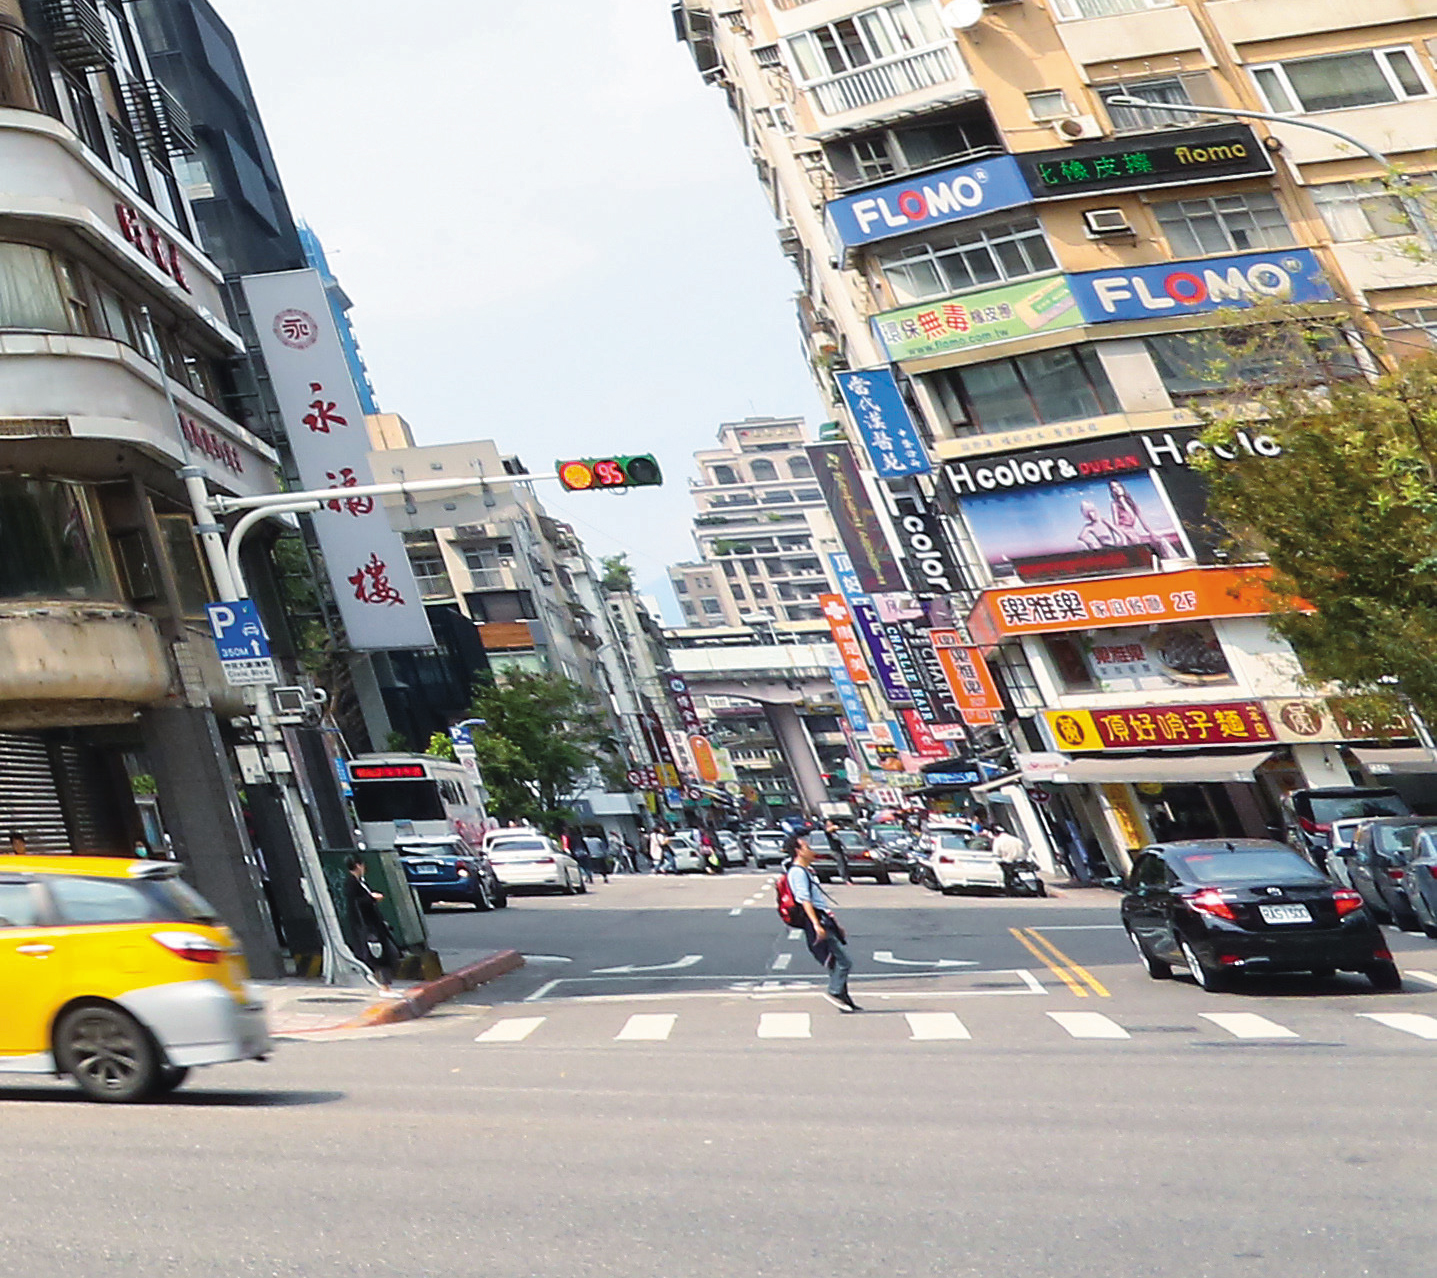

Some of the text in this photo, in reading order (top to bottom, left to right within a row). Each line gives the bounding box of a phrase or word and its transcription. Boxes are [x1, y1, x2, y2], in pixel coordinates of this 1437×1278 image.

[851, 172, 984, 235] FLOMO
[1092, 260, 1292, 314] FLOMO
[301, 382, 408, 609] 永福樓
[208, 604, 236, 639] P
[1170, 591, 1198, 613] 2F
